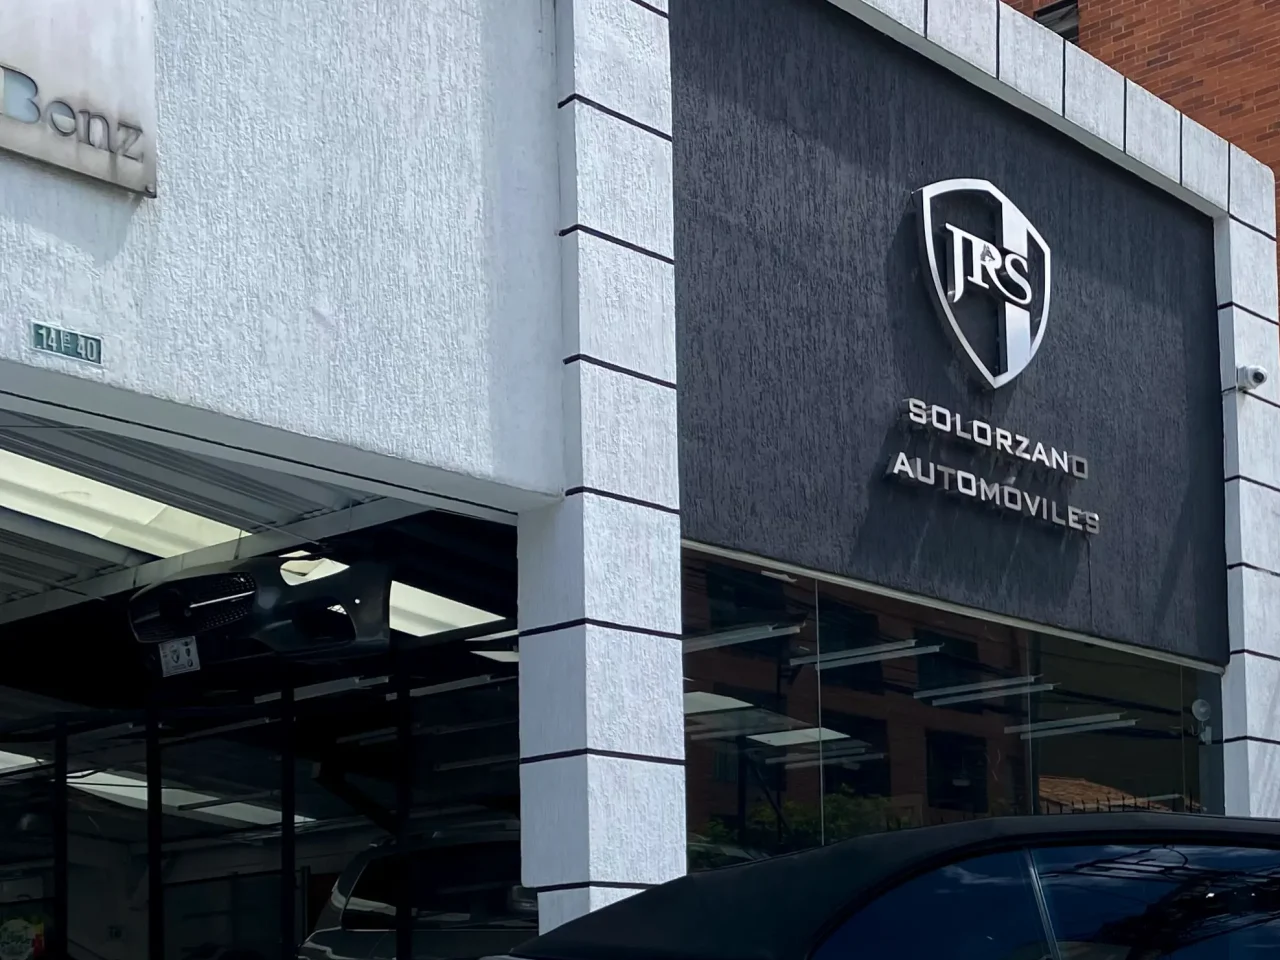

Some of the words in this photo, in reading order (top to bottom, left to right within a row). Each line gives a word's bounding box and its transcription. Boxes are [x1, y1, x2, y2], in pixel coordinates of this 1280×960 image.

[945, 222, 1032, 305] JRS
[77, 334, 97, 361] 40
[908, 397, 1089, 480] SOLORZANO
[892, 451, 1100, 535] AUTOMOVILES
